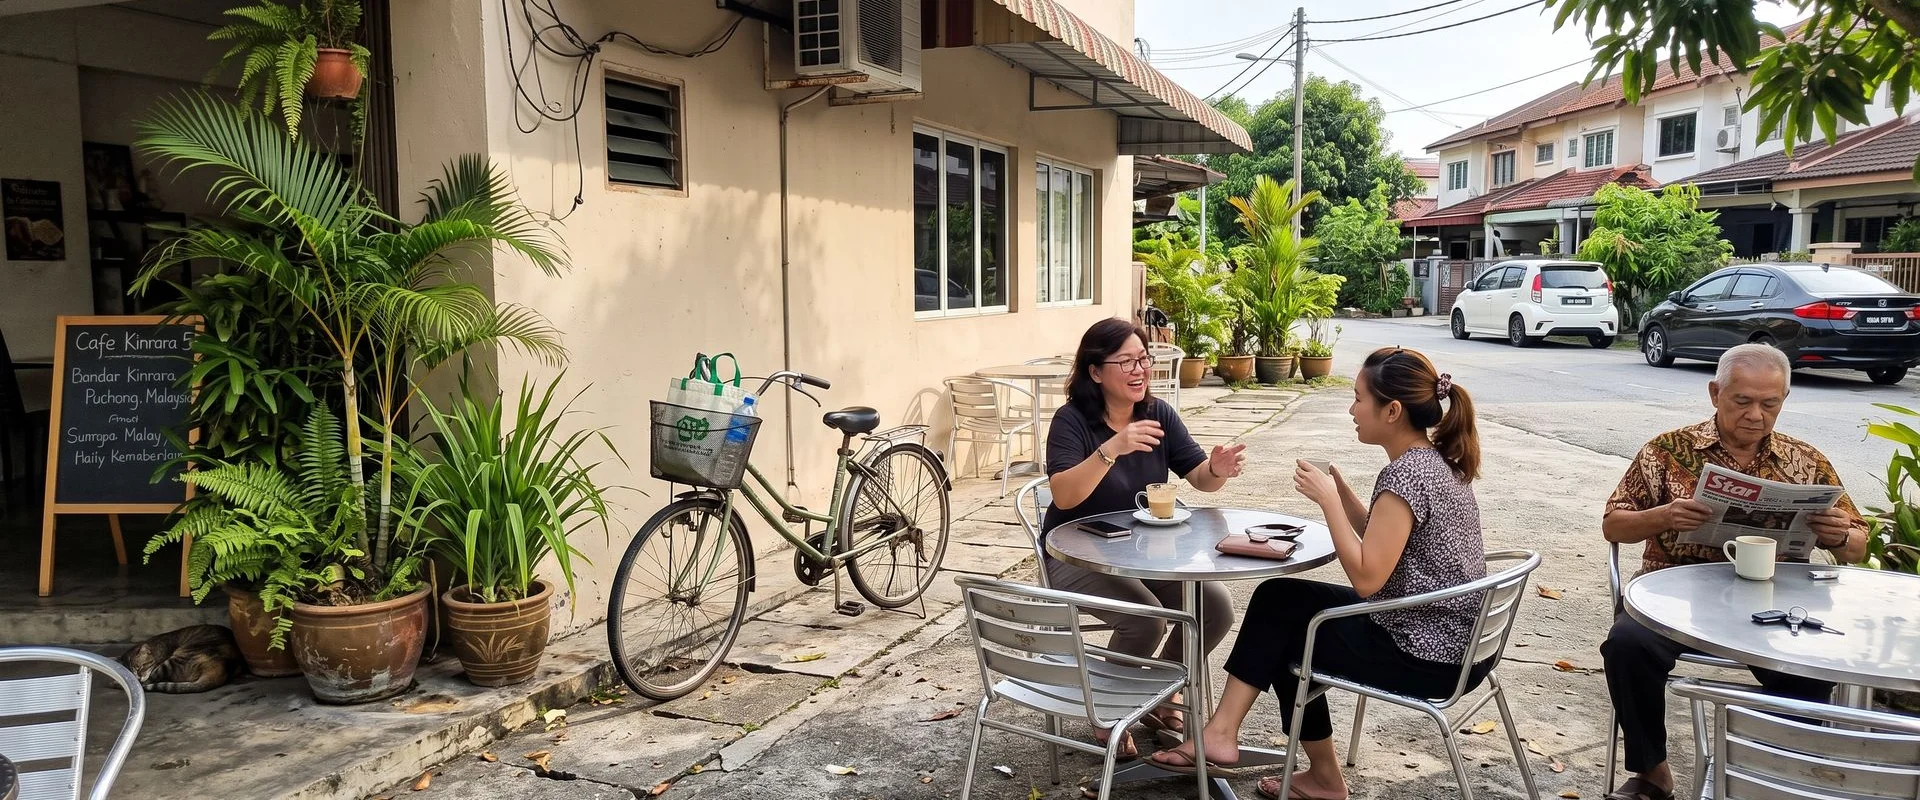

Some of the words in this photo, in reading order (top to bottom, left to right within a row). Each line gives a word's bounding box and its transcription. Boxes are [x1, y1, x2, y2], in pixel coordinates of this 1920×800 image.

[75, 331, 116, 359] Cafe
[124, 331, 178, 352] Kinrara
[72, 366, 121, 384] Bandar
[1707, 475, 1757, 498] Star
